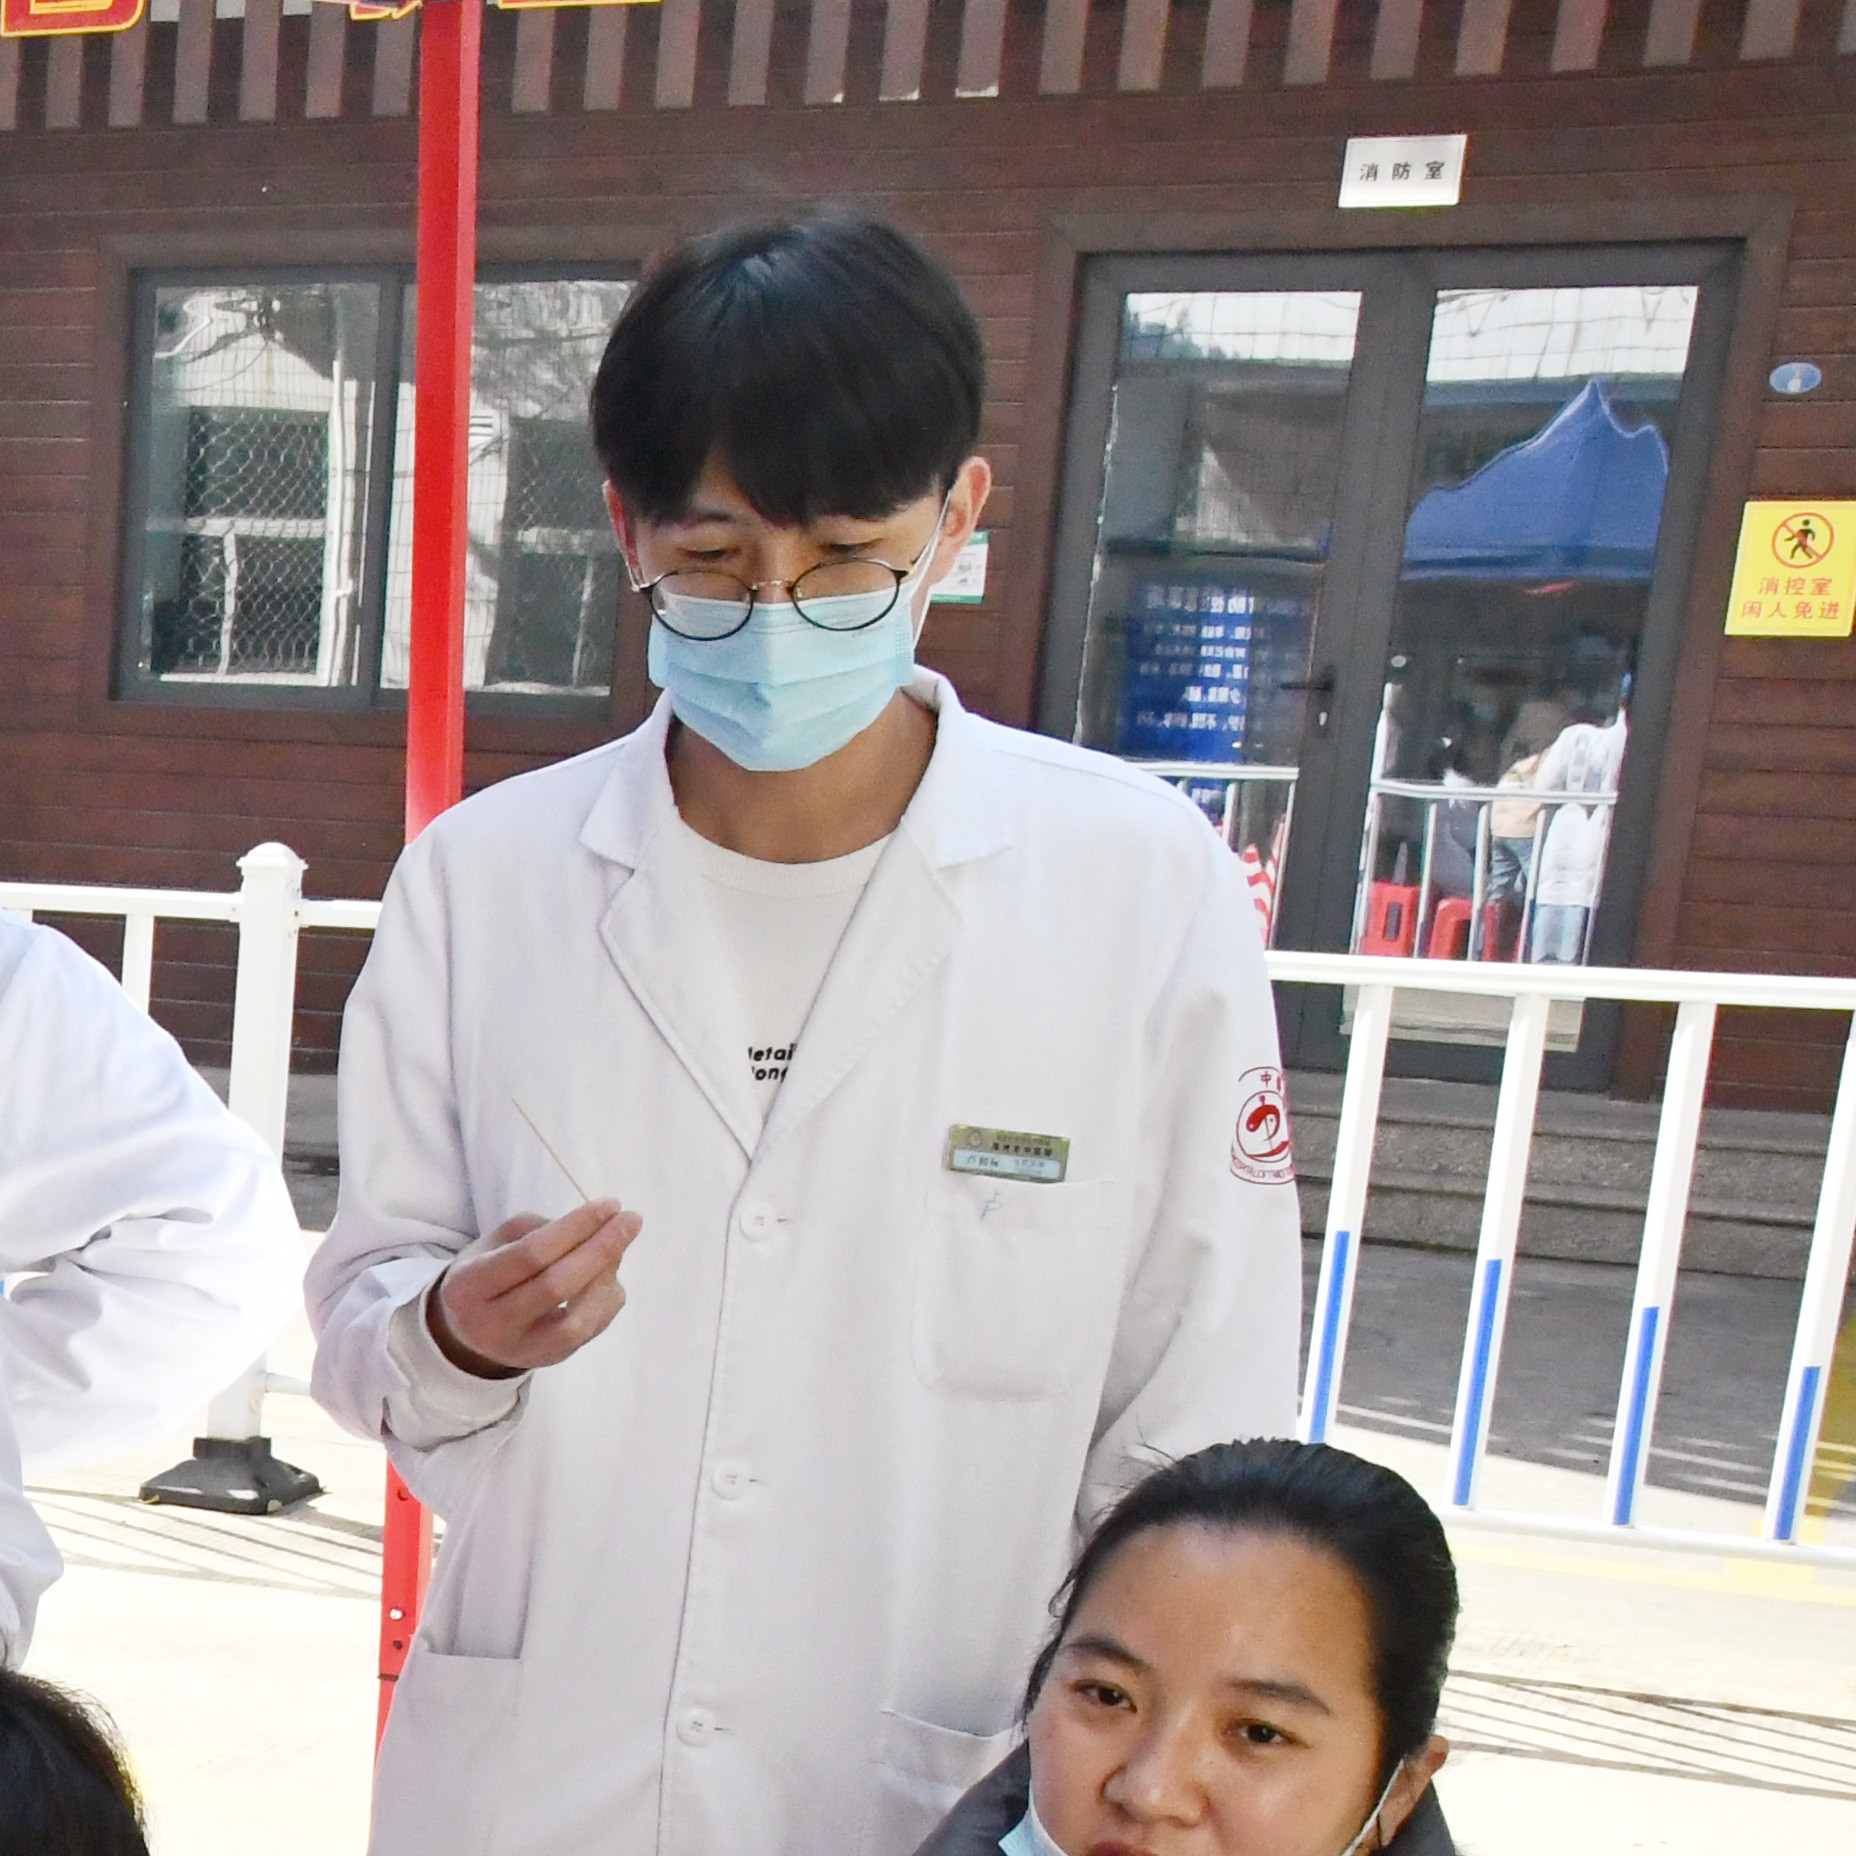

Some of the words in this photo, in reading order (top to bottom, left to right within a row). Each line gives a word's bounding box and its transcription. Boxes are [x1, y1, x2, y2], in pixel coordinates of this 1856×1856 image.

[1358, 159, 1446, 184] 消防室
[1758, 577, 1832, 596] 消控室
[1741, 600, 1840, 620] 闲人免进
